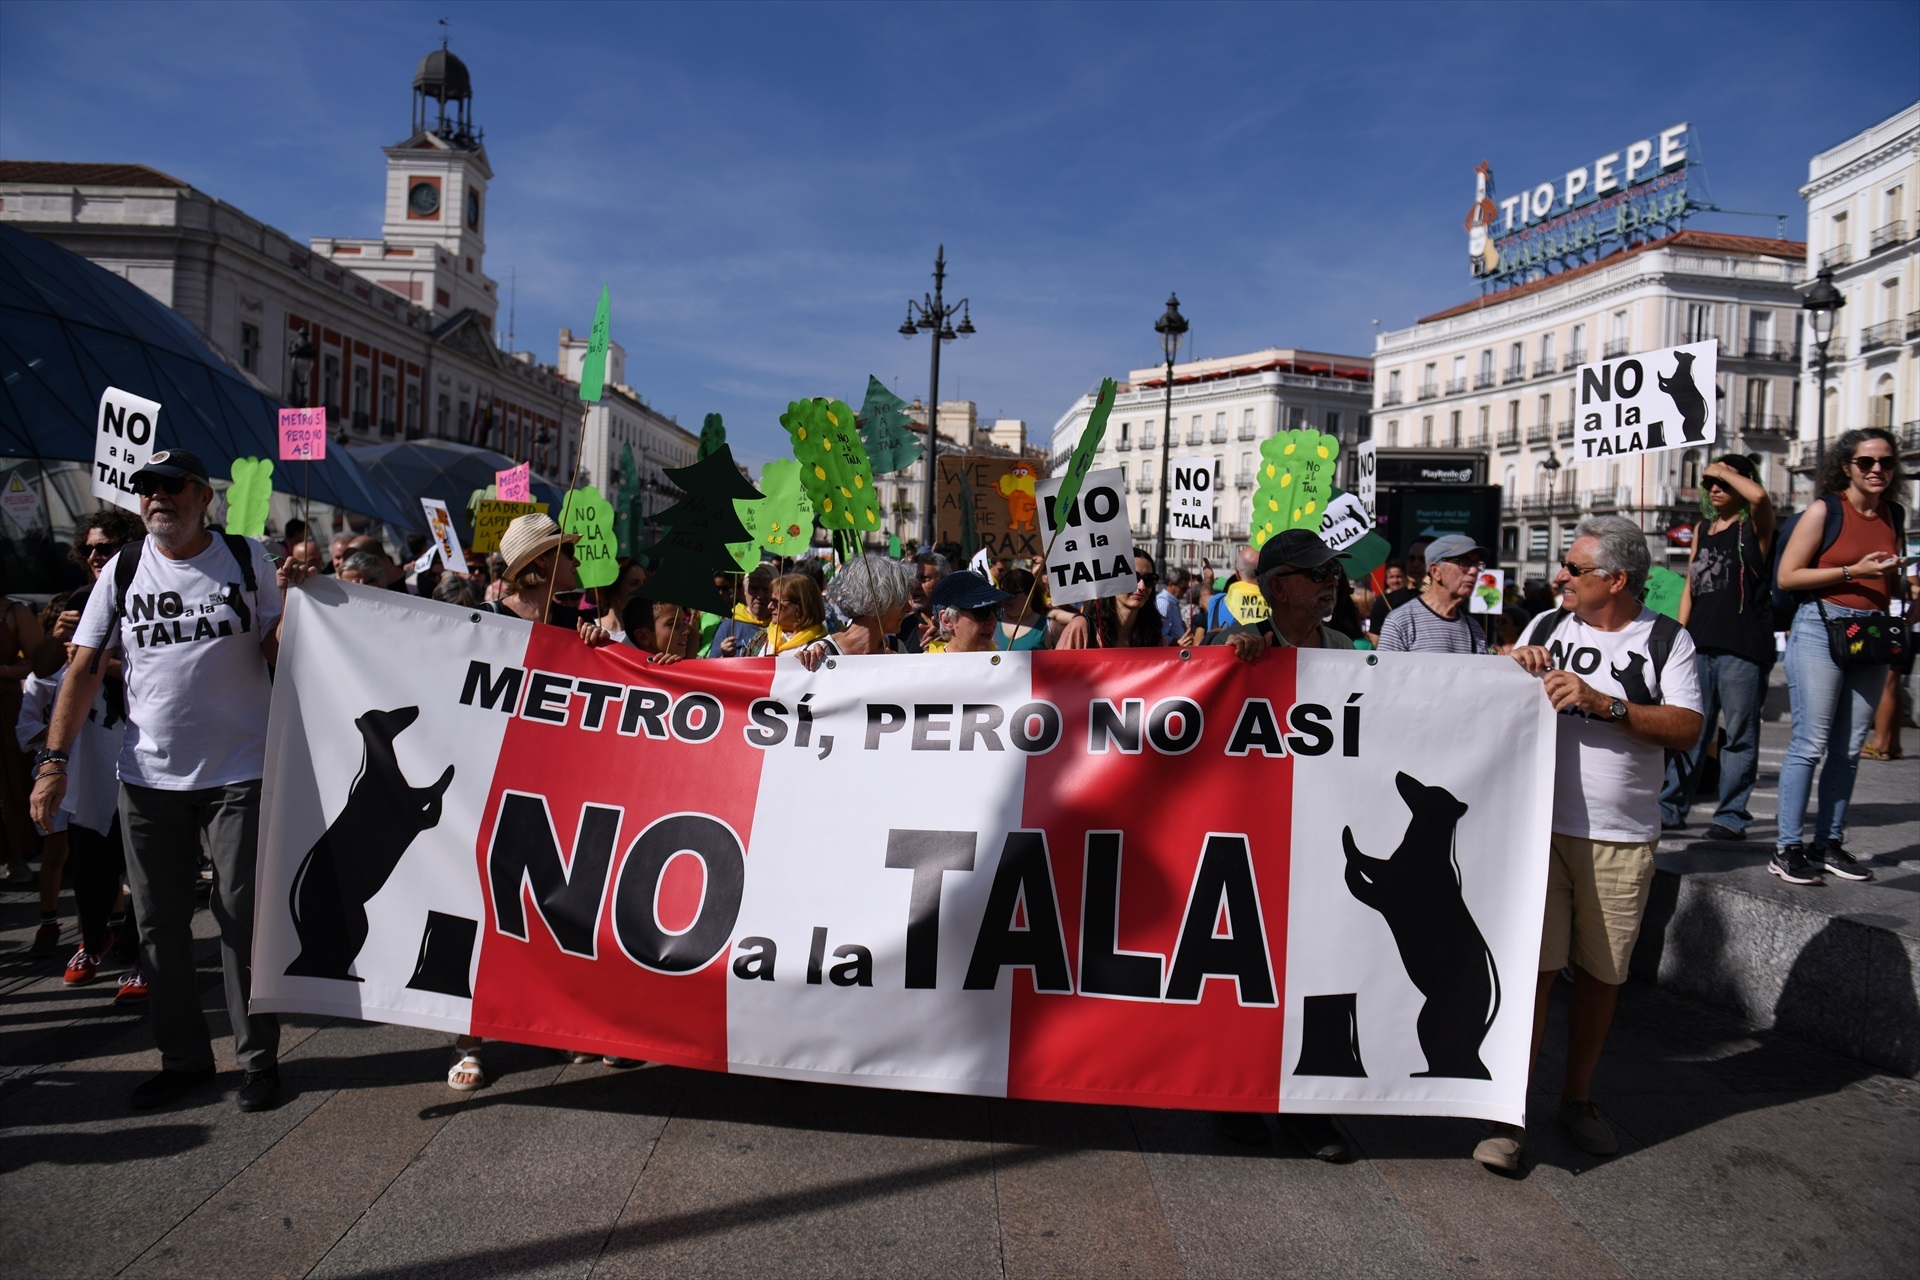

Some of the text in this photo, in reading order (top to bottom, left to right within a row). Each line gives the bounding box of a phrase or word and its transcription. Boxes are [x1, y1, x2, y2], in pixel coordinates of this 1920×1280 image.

[1501, 182, 1555, 230] TIO
[1566, 122, 1689, 206] PEPE
[1582, 359, 1644, 405] NO
[874, 403, 891, 416] NO
[1584, 403, 1641, 432] a la
[103, 401, 151, 446] NO
[281, 413, 313, 426] METRO
[880, 417, 888, 426] A
[285, 429, 322, 442] PERO NO
[879, 428, 892, 439] LA
[877, 439, 903, 451] TALA
[1582, 431, 1644, 458] TALA
[109, 446, 135, 465] a la
[941, 460, 991, 488] WE
[1361, 452, 1375, 479] NO
[1175, 467, 1210, 491] NO
[480, 502, 536, 515] MADRID
[942, 493, 989, 511] AE
[1044, 486, 1120, 532] NO
[1181, 496, 1202, 507] a la
[480, 516, 511, 527] CAPIT
[576, 506, 596, 521] NO
[973, 511, 997, 526] HE
[1173, 512, 1212, 530] TALA
[587, 524, 604, 541] LA
[576, 543, 611, 560] TALA
[943, 530, 1038, 557] RAX
[1065, 533, 1109, 552] a la
[1050, 554, 1133, 588] TALA
[132, 591, 215, 623] NO a la
[1242, 595, 1259, 606] NO
[1240, 607, 1270, 619] TALA
[131, 616, 217, 648] TALA
[1549, 639, 1602, 675] NO
[460, 660, 1364, 760] METRO SÍ, PERO NO ASÍ
[488, 789, 1279, 1007] NO a la TALA
